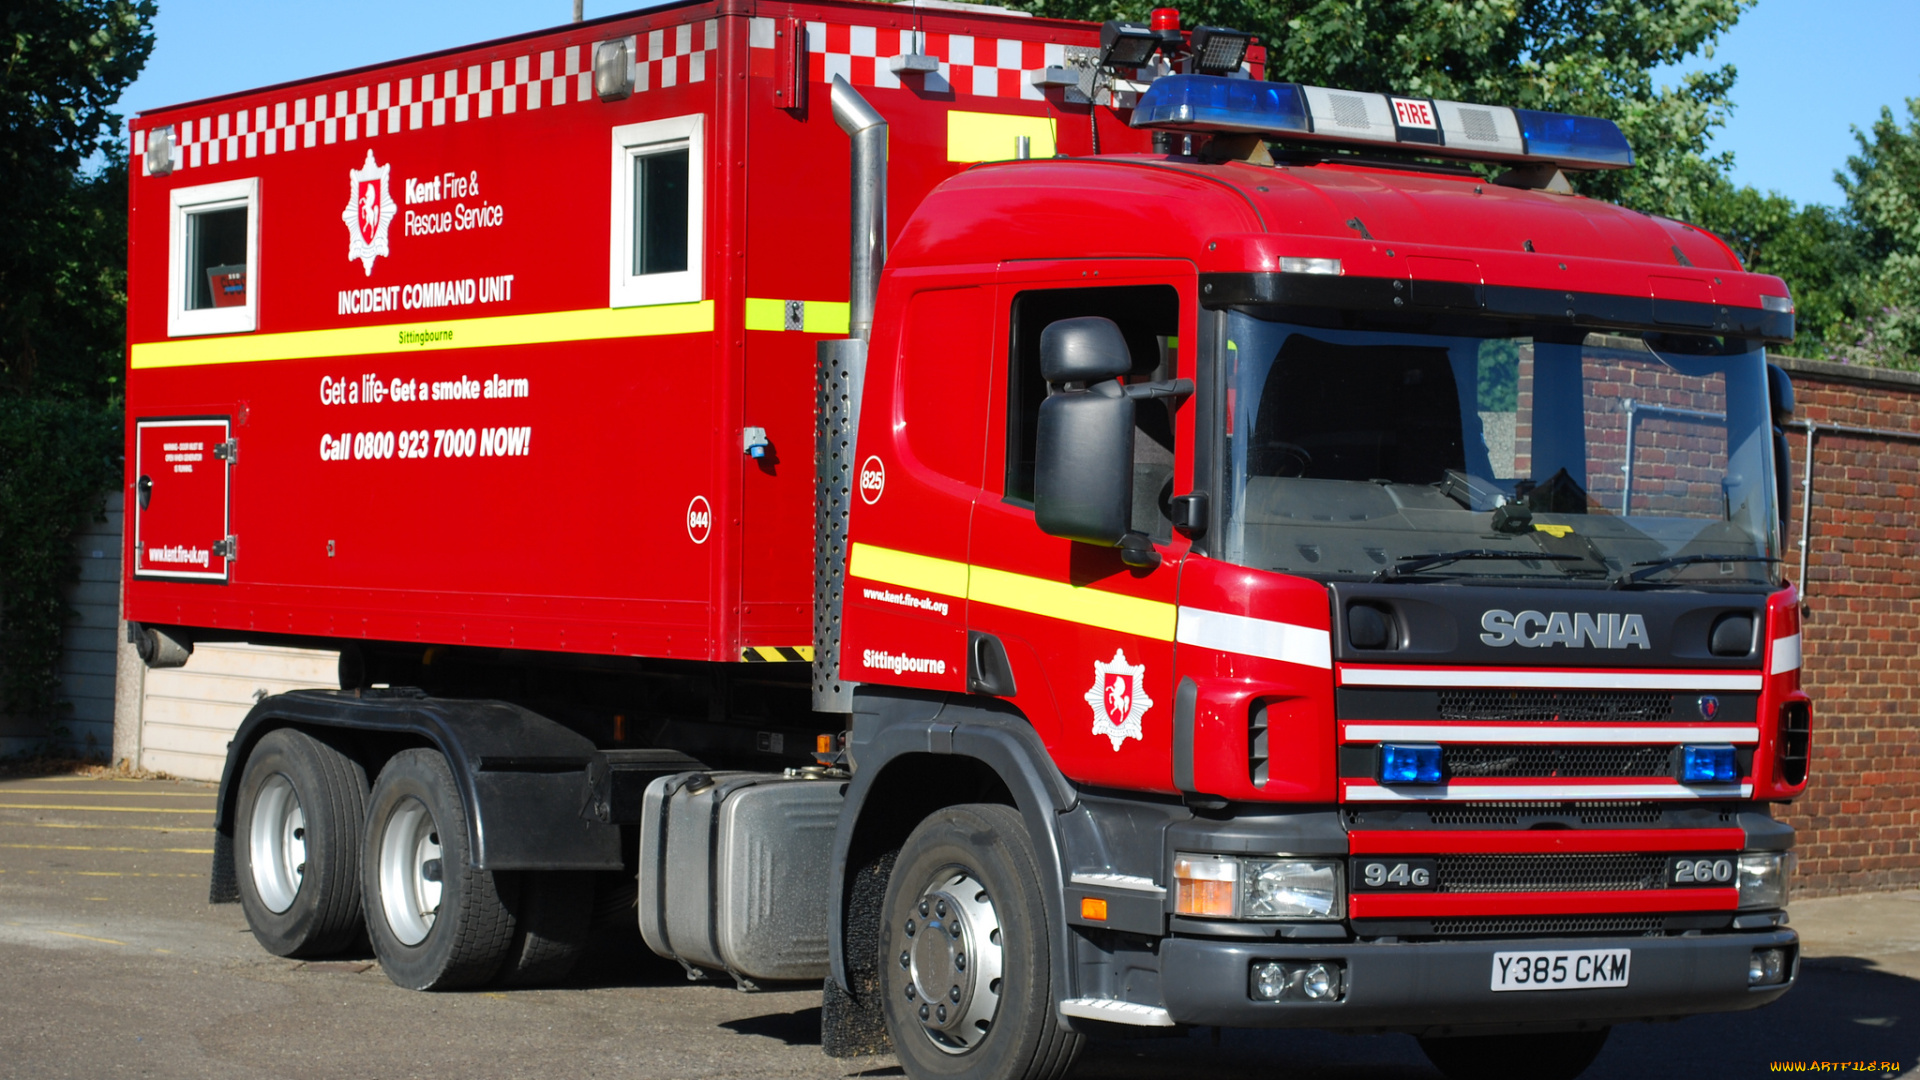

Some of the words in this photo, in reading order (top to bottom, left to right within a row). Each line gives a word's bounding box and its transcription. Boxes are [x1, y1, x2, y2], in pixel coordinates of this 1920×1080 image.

[1395, 101, 1431, 126] FIRE
[405, 176, 441, 204] Kent
[444, 173, 467, 199] Fire
[469, 171, 479, 196] &
[405, 210, 452, 236] Rescue
[455, 201, 503, 230] Service
[338, 286, 400, 315] INCIDENT
[402, 279, 476, 309] COMMAND
[479, 275, 514, 303] UNIT
[398, 328, 453, 346] Sittingbourne
[320, 376, 346, 405] Get
[349, 382, 358, 404] a
[419, 383, 428, 401] a
[432, 375, 480, 400] smoke
[484, 374, 528, 398] alarm
[320, 433, 351, 461] Call
[354, 431, 394, 460] 0800
[398, 430, 429, 459] 923
[434, 428, 476, 458] 7000
[480, 427, 531, 456] NOW!
[862, 470, 882, 490] 825
[690, 511, 709, 528] 844
[863, 588, 949, 616] www.kent.fire-uk.org
[1480, 609, 1650, 649] SCANIA
[863, 649, 945, 675] Sittingbourne
[1365, 863, 1429, 886] 94G
[1675, 860, 1732, 882] 260
[1499, 956, 1568, 984] Y385
[1576, 954, 1627, 982] CKM
